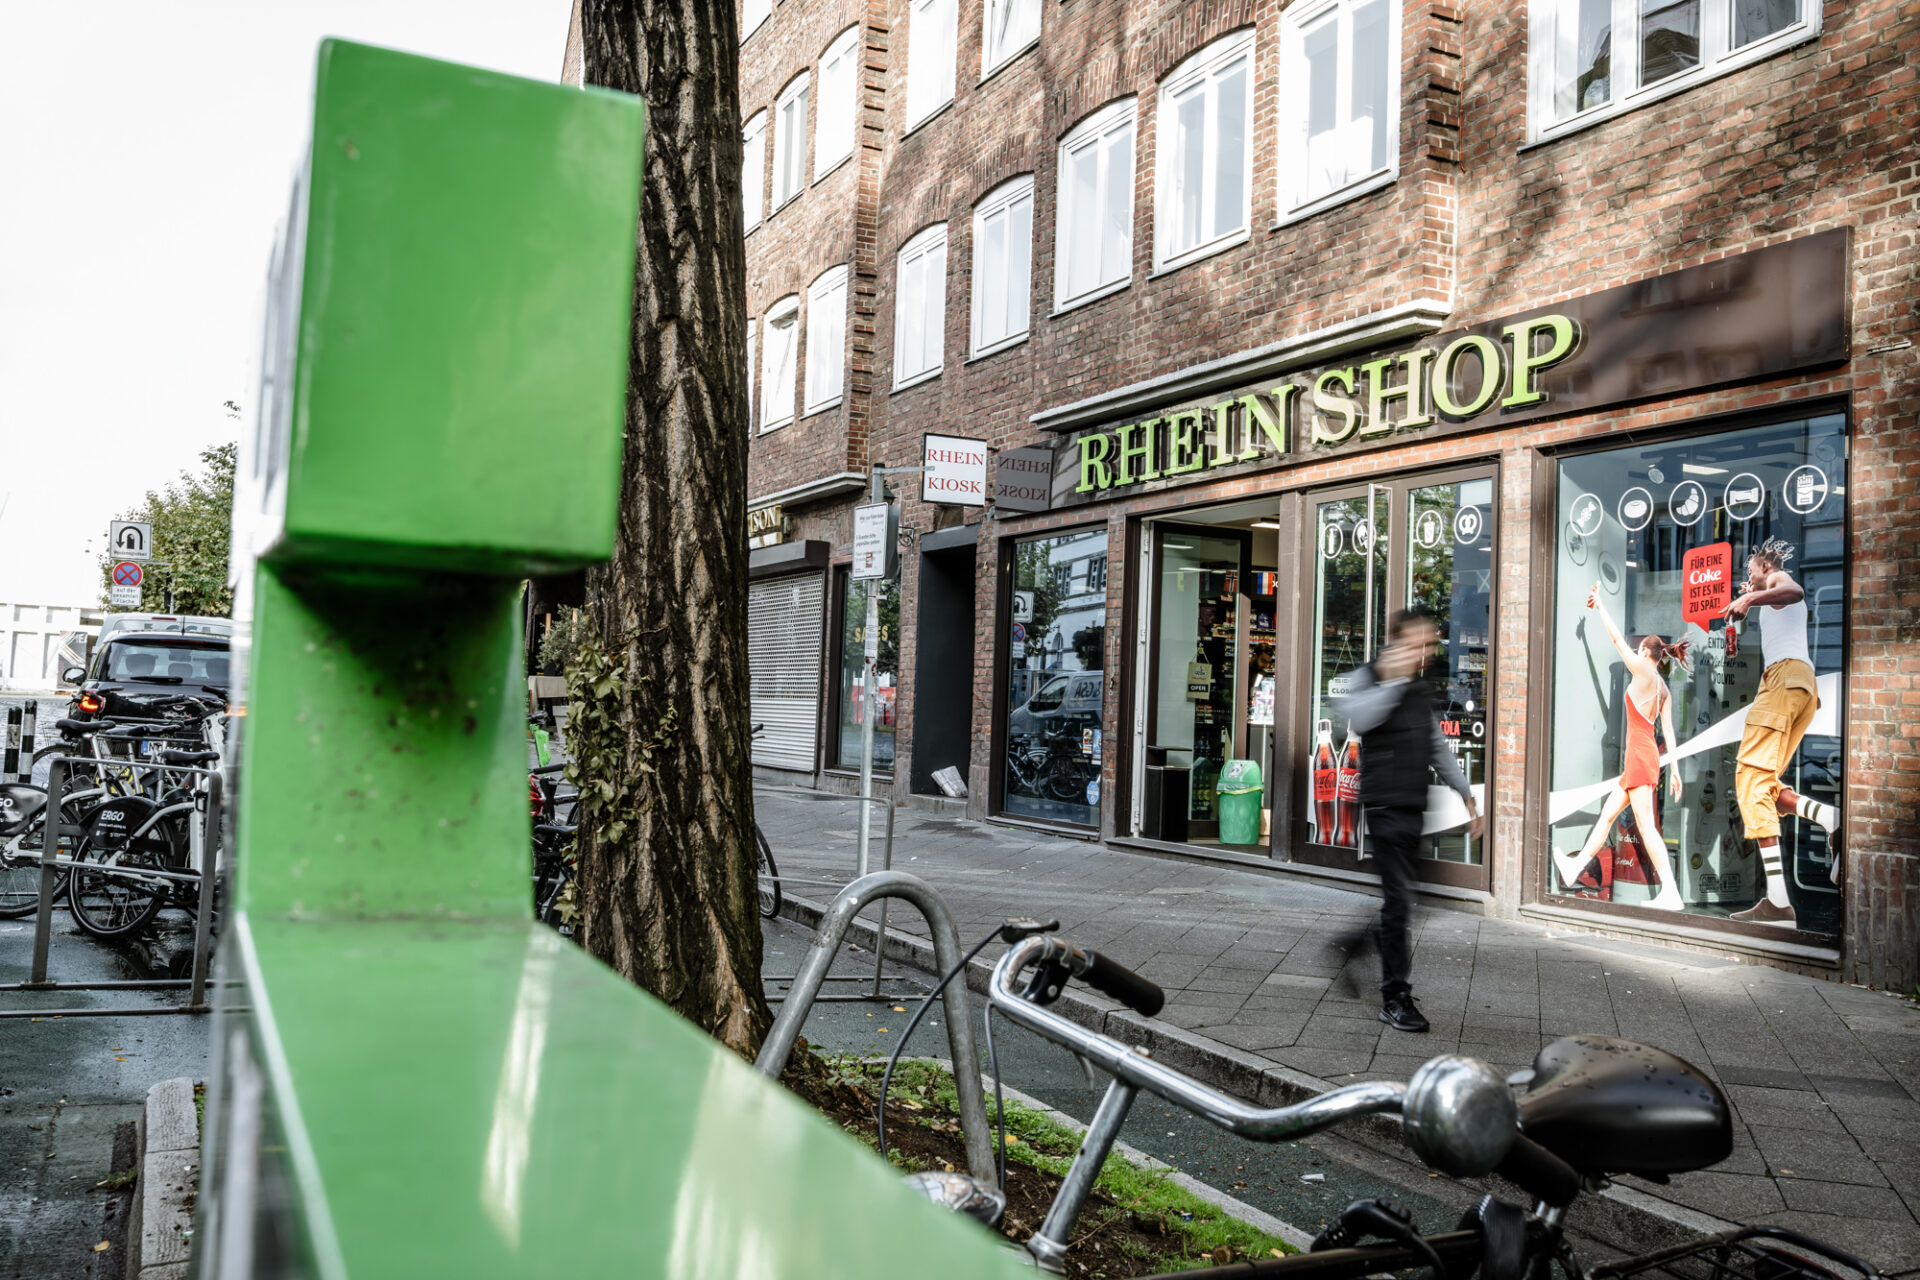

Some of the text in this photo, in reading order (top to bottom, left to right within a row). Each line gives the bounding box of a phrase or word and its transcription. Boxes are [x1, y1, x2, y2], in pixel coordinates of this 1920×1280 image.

[1076, 314, 1579, 493] RHEIN SHOP
[927, 448, 984, 466] RHEIN
[928, 477, 981, 494] KIOSK
[1690, 553, 1723, 570] FÜR EINE
[1689, 568, 1722, 585] Coke
[1690, 582, 1725, 599] IST ES NIE
[1689, 596, 1721, 613] ZU SPÄT!
[101, 810, 125, 822] ERGO
